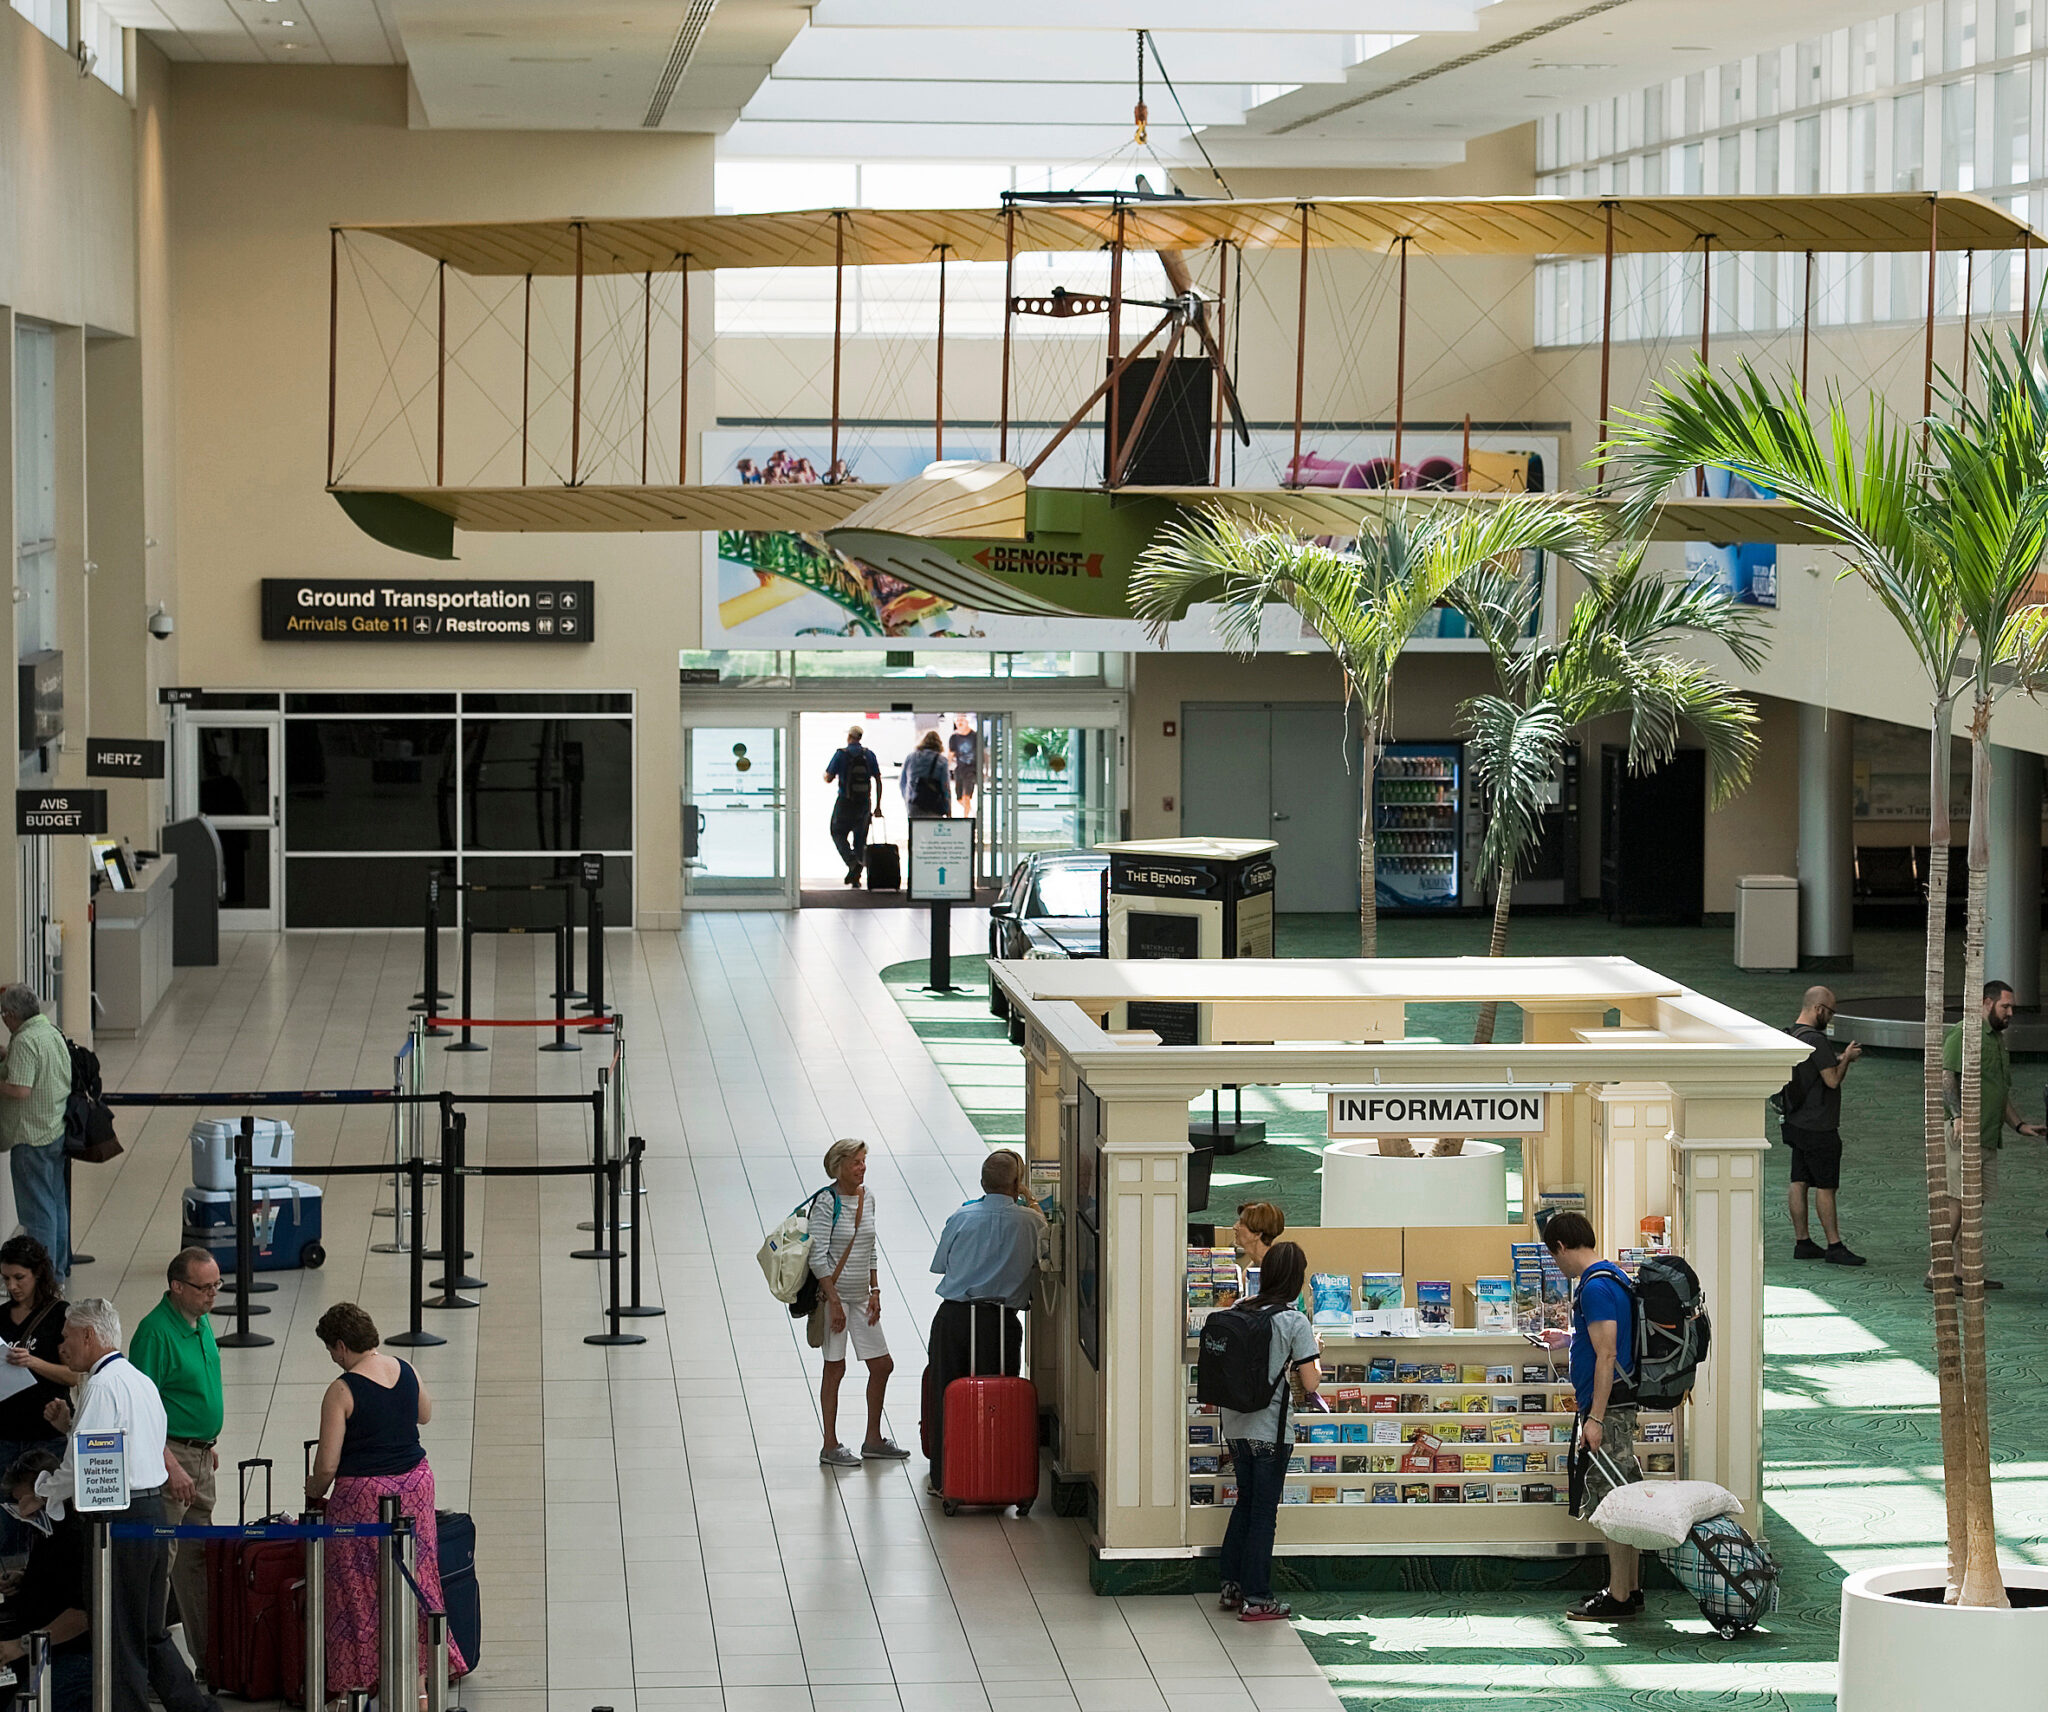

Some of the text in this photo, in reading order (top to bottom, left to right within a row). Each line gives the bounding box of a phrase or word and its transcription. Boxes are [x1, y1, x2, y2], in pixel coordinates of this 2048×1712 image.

[993, 546, 1083, 577] BENOIST
[297, 588, 531, 612] Ground Transportation
[287, 615, 347, 632] Arrivals
[351, 616, 390, 632] Gate
[392, 617, 408, 632] 11
[446, 617, 531, 633] Restrooms
[97, 752, 142, 766] HERTZ
[39, 798, 69, 810] AVIS
[26, 814, 82, 827] BUDGET
[1125, 869, 1148, 882] THE
[1150, 871, 1198, 886] BENOIST
[1338, 1098, 1540, 1122] INFORMATION
[88, 1439, 114, 1447] Alamo
[89, 1458, 113, 1466] Please
[84, 1467, 119, 1476] Wait Here
[86, 1477, 98, 1485] For
[86, 1486, 119, 1494] Available
[91, 1496, 114, 1505] Agent
[334, 1526, 355, 1534] Alamo
